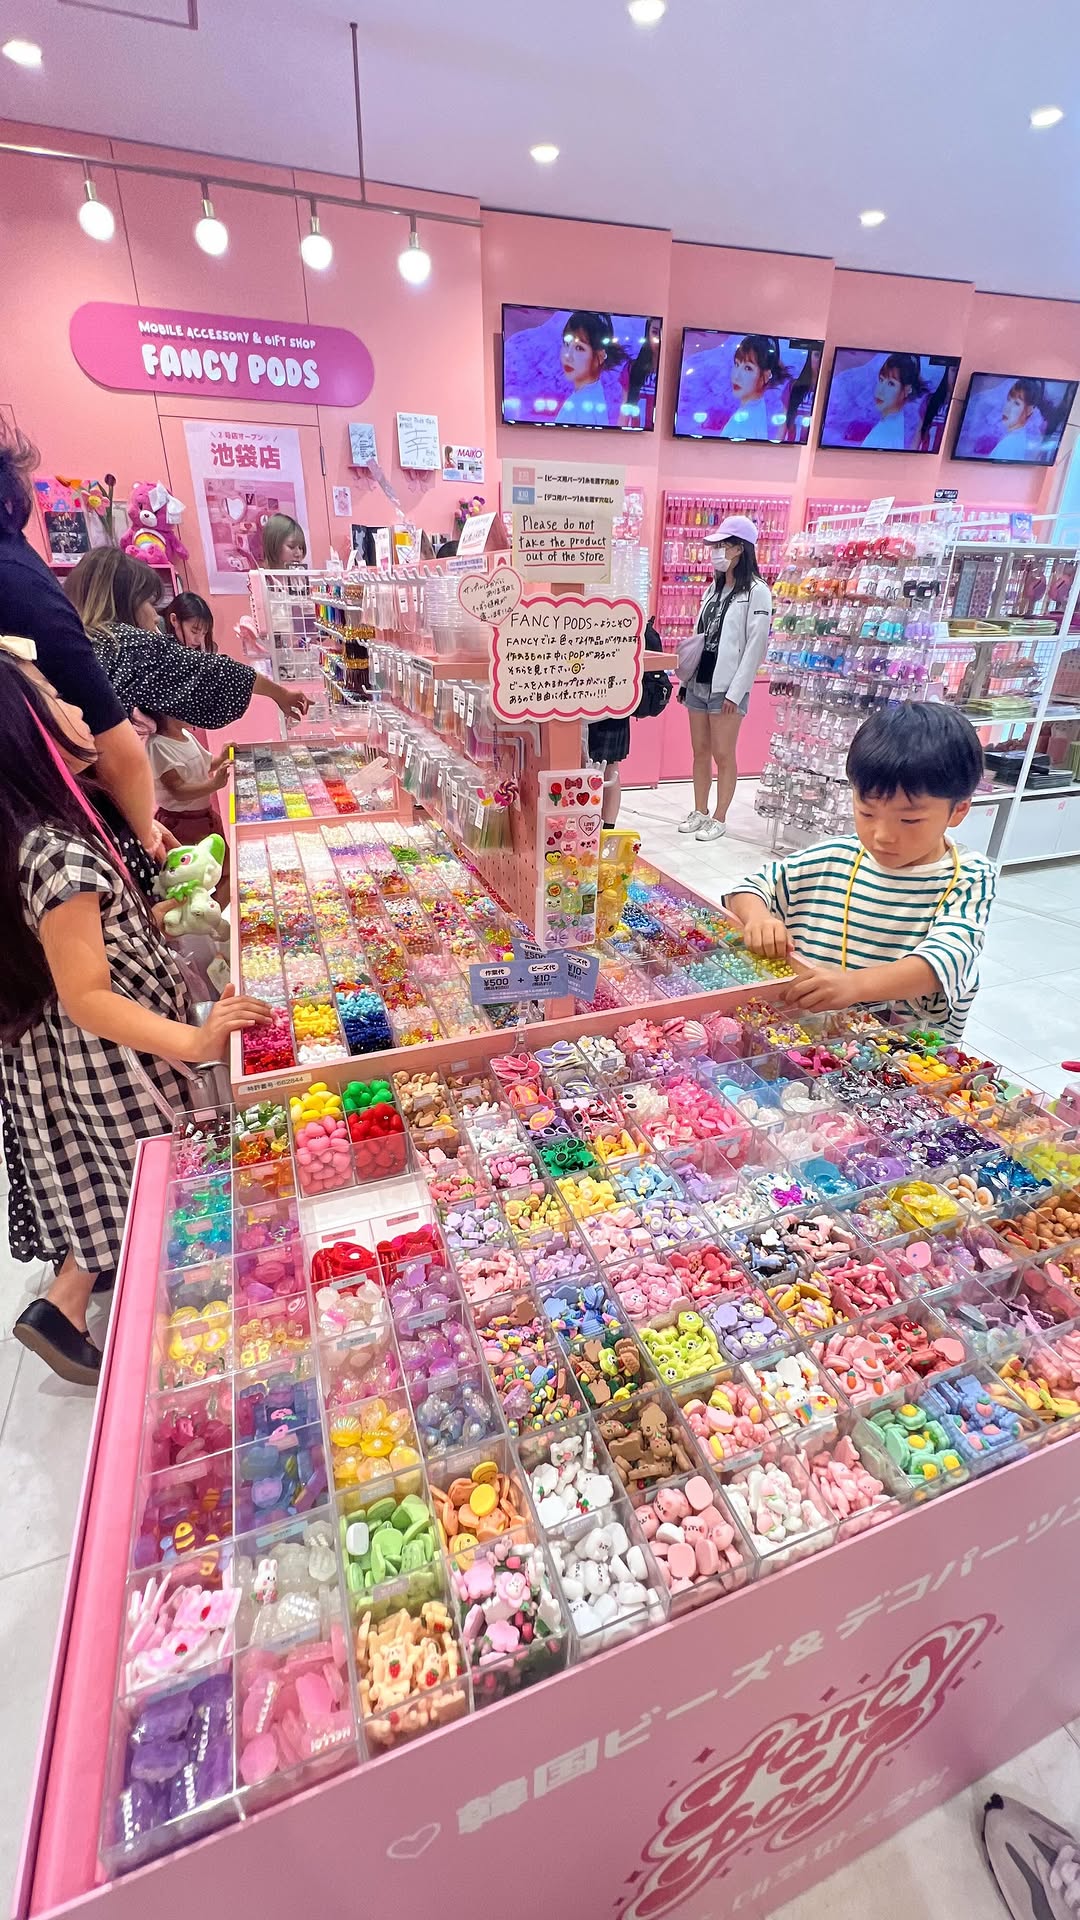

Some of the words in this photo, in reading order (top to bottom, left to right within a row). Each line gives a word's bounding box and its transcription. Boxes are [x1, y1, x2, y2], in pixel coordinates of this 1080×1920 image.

[138, 320, 184, 337] MOBILE
[187, 327, 249, 344] ACCESSORY
[253, 332, 262, 344] &
[264, 335, 286, 348] GIFT
[290, 338, 316, 350] SHOP
[141, 343, 239, 383] FANCY
[248, 354, 320, 390] PODS
[210, 442, 281, 470] 池袋店
[457, 448, 482, 458] MAIKO
[522, 514, 557, 530] Please
[564, 518, 574, 530] do
[578, 520, 594, 530] not
[519, 536, 545, 549] take
[550, 536, 568, 548] the
[570, 536, 606, 549] product
[526, 552, 543, 562] out
[548, 550, 558, 562] of
[562, 551, 576, 562] the
[510, 612, 560, 630] FANCY
[531, 964, 556, 972] ビーズ代
[484, 978, 509, 987] ¥500
